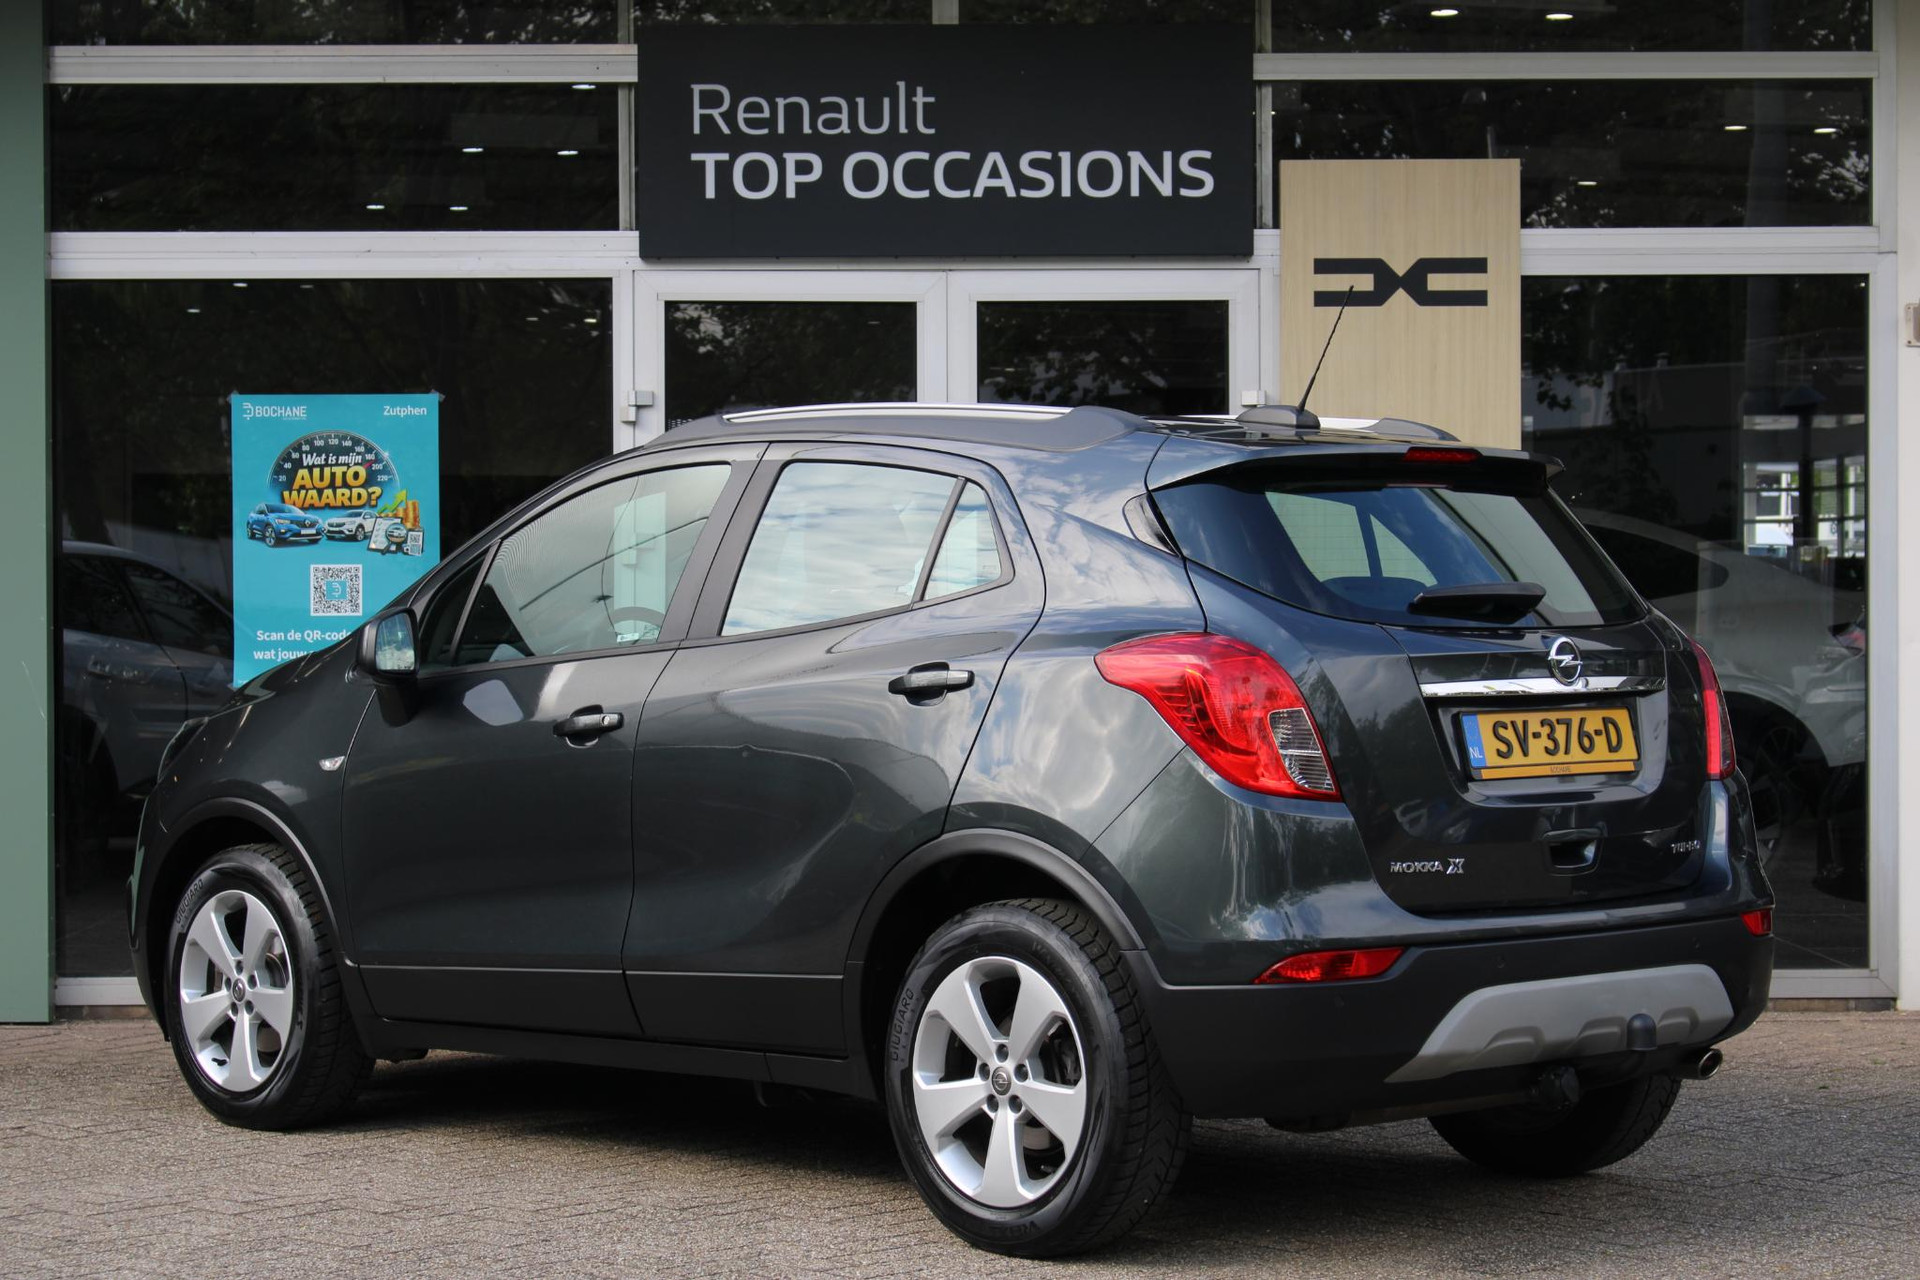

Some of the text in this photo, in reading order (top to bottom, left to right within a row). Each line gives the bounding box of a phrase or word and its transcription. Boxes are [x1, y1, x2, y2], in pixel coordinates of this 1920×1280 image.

[691, 81, 936, 135] Renault
[691, 150, 1215, 200] TOP OCCASIONS
[255, 406, 307, 418] BOCHANE
[383, 405, 427, 419] Zutphen
[302, 453, 362, 467] Wat is mijn
[292, 466, 367, 489] AUTO
[283, 487, 382, 508] WAARD?
[256, 630, 351, 643] Scan de QR-cod
[253, 649, 275, 660] wat
[277, 648, 307, 661] jouw
[1492, 716, 1623, 759] SV-376-D
[1469, 747, 1483, 759] NL
[1390, 858, 1465, 875] MOKKA X
[891, 987, 915, 1062] GIUGIARO
